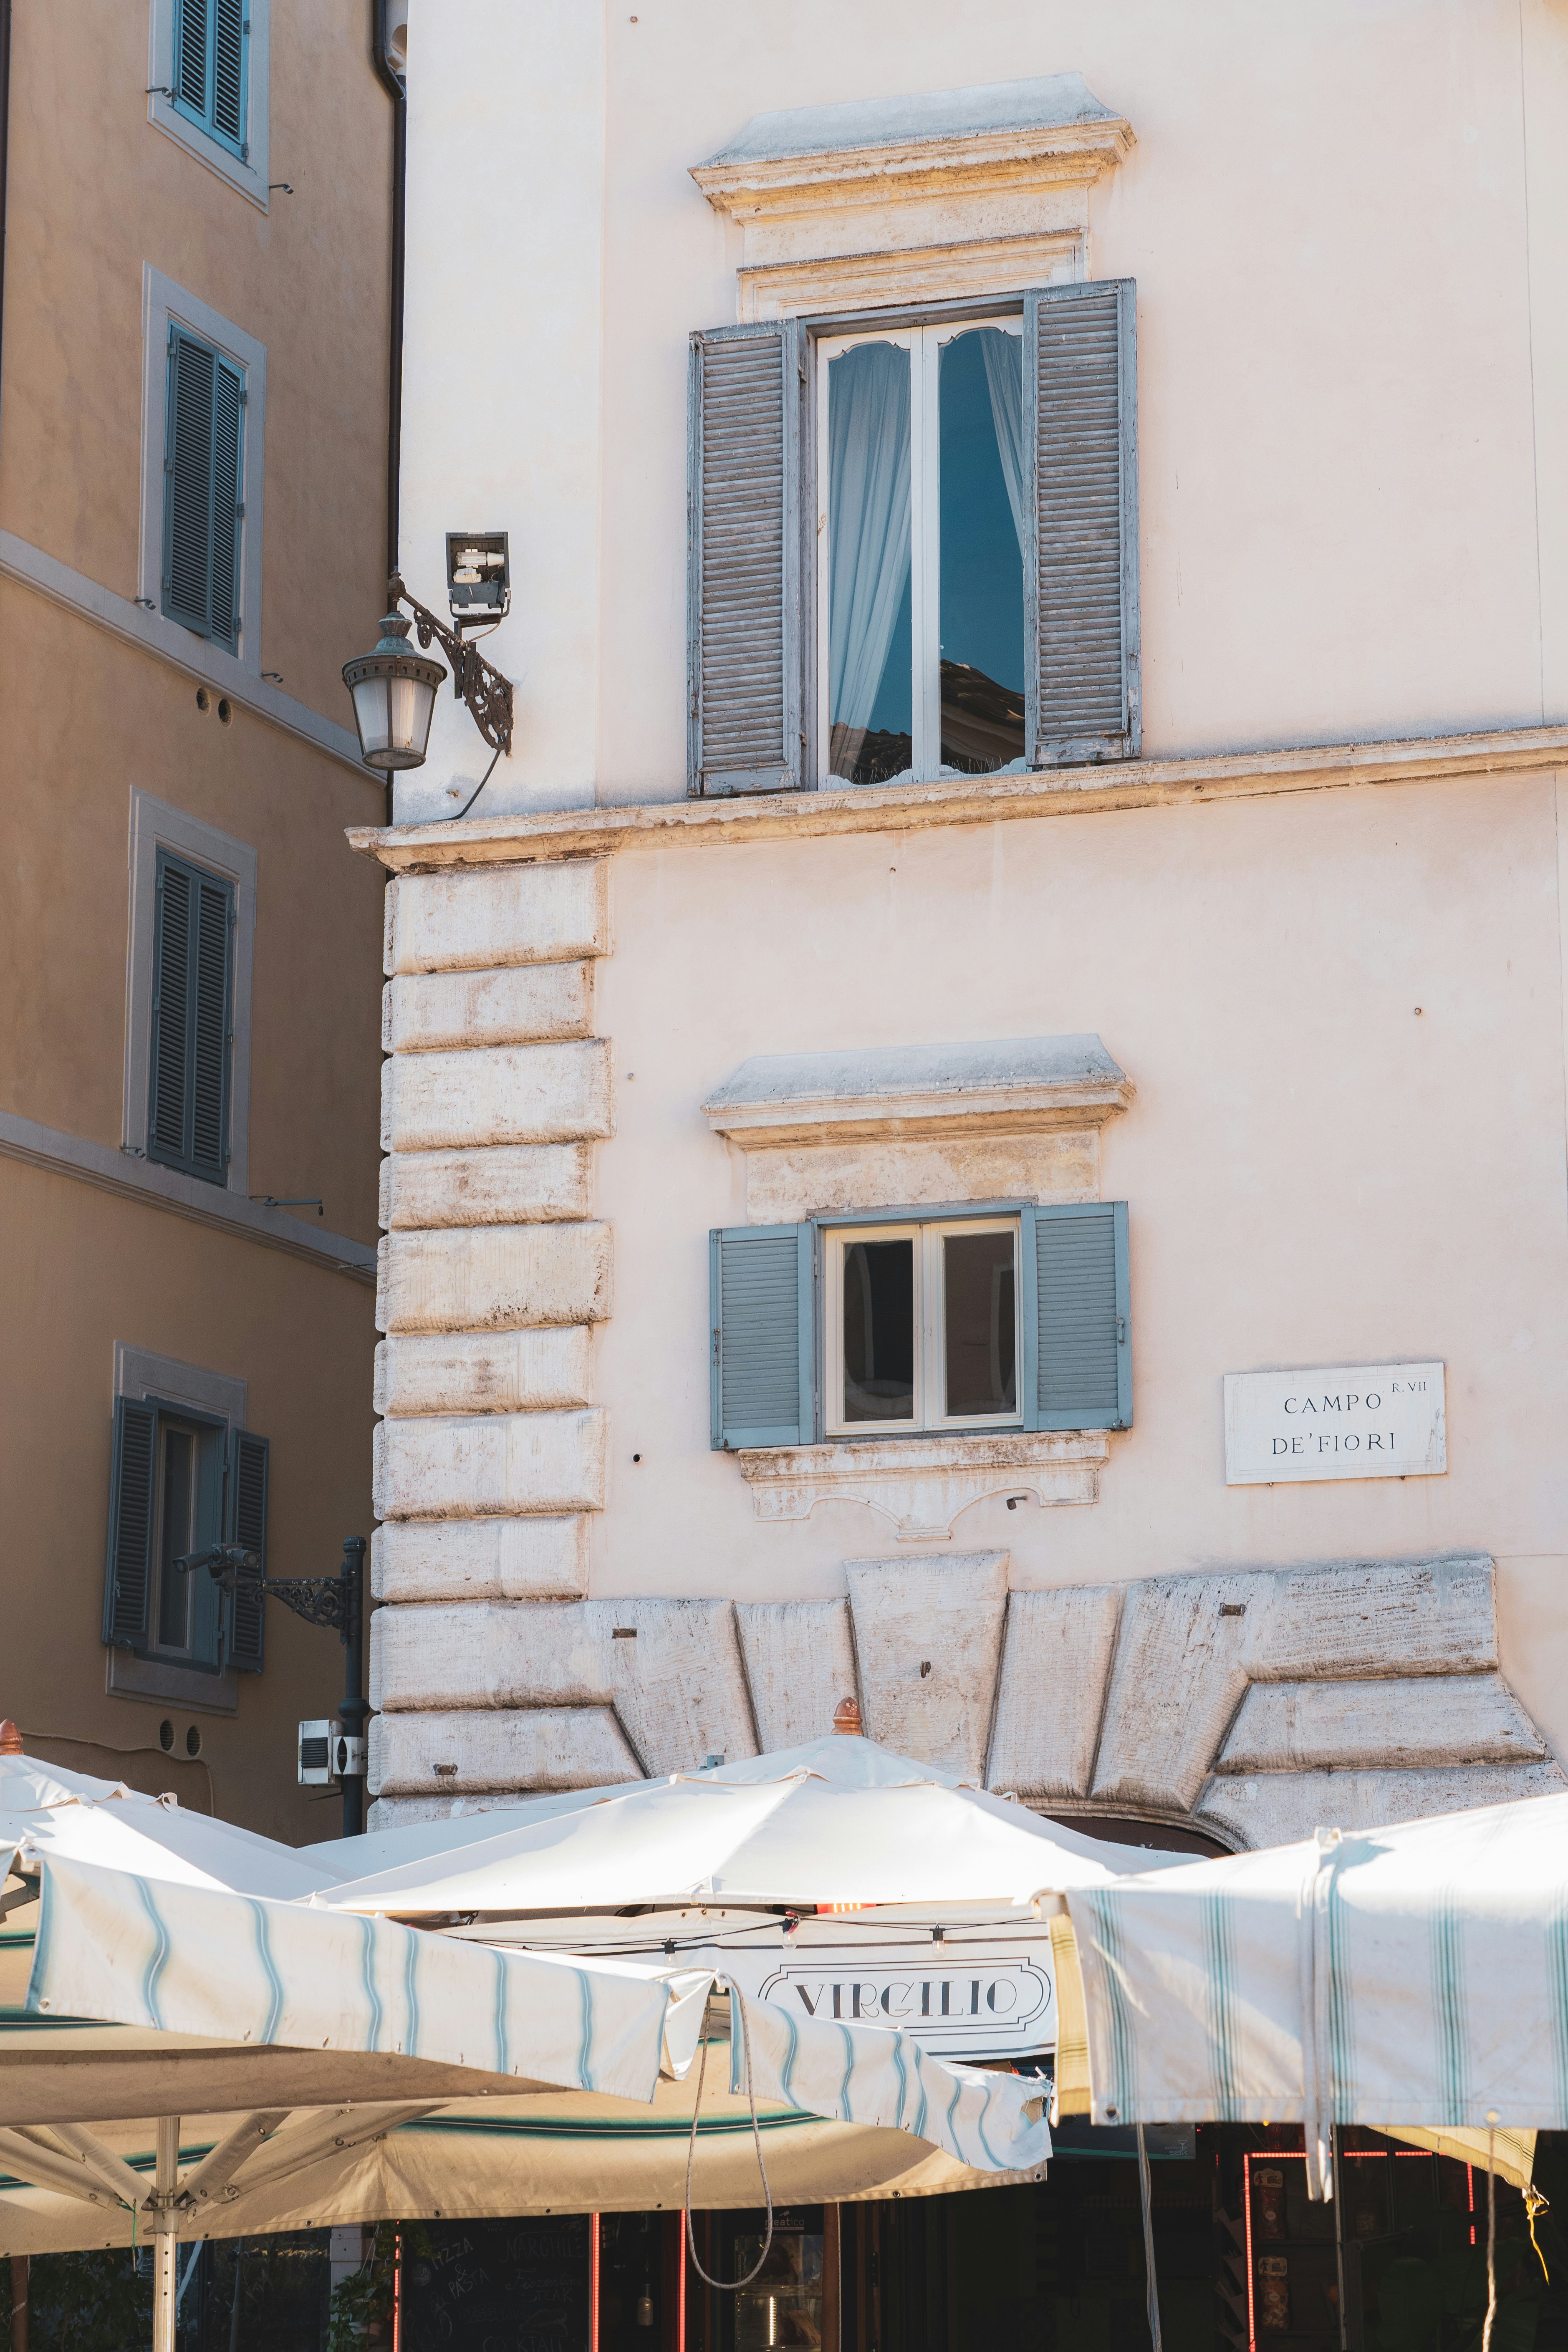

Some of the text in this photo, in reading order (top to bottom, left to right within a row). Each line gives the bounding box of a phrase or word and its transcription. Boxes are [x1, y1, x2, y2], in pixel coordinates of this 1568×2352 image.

[1392, 1381, 1427, 1393] R. VII
[1284, 1393, 1381, 1413] CAMPO
[794, 1979, 1017, 2019] VIRGILIO
[448, 2268, 490, 2299] PASTA
[521, 2287, 573, 2302] STEAK
